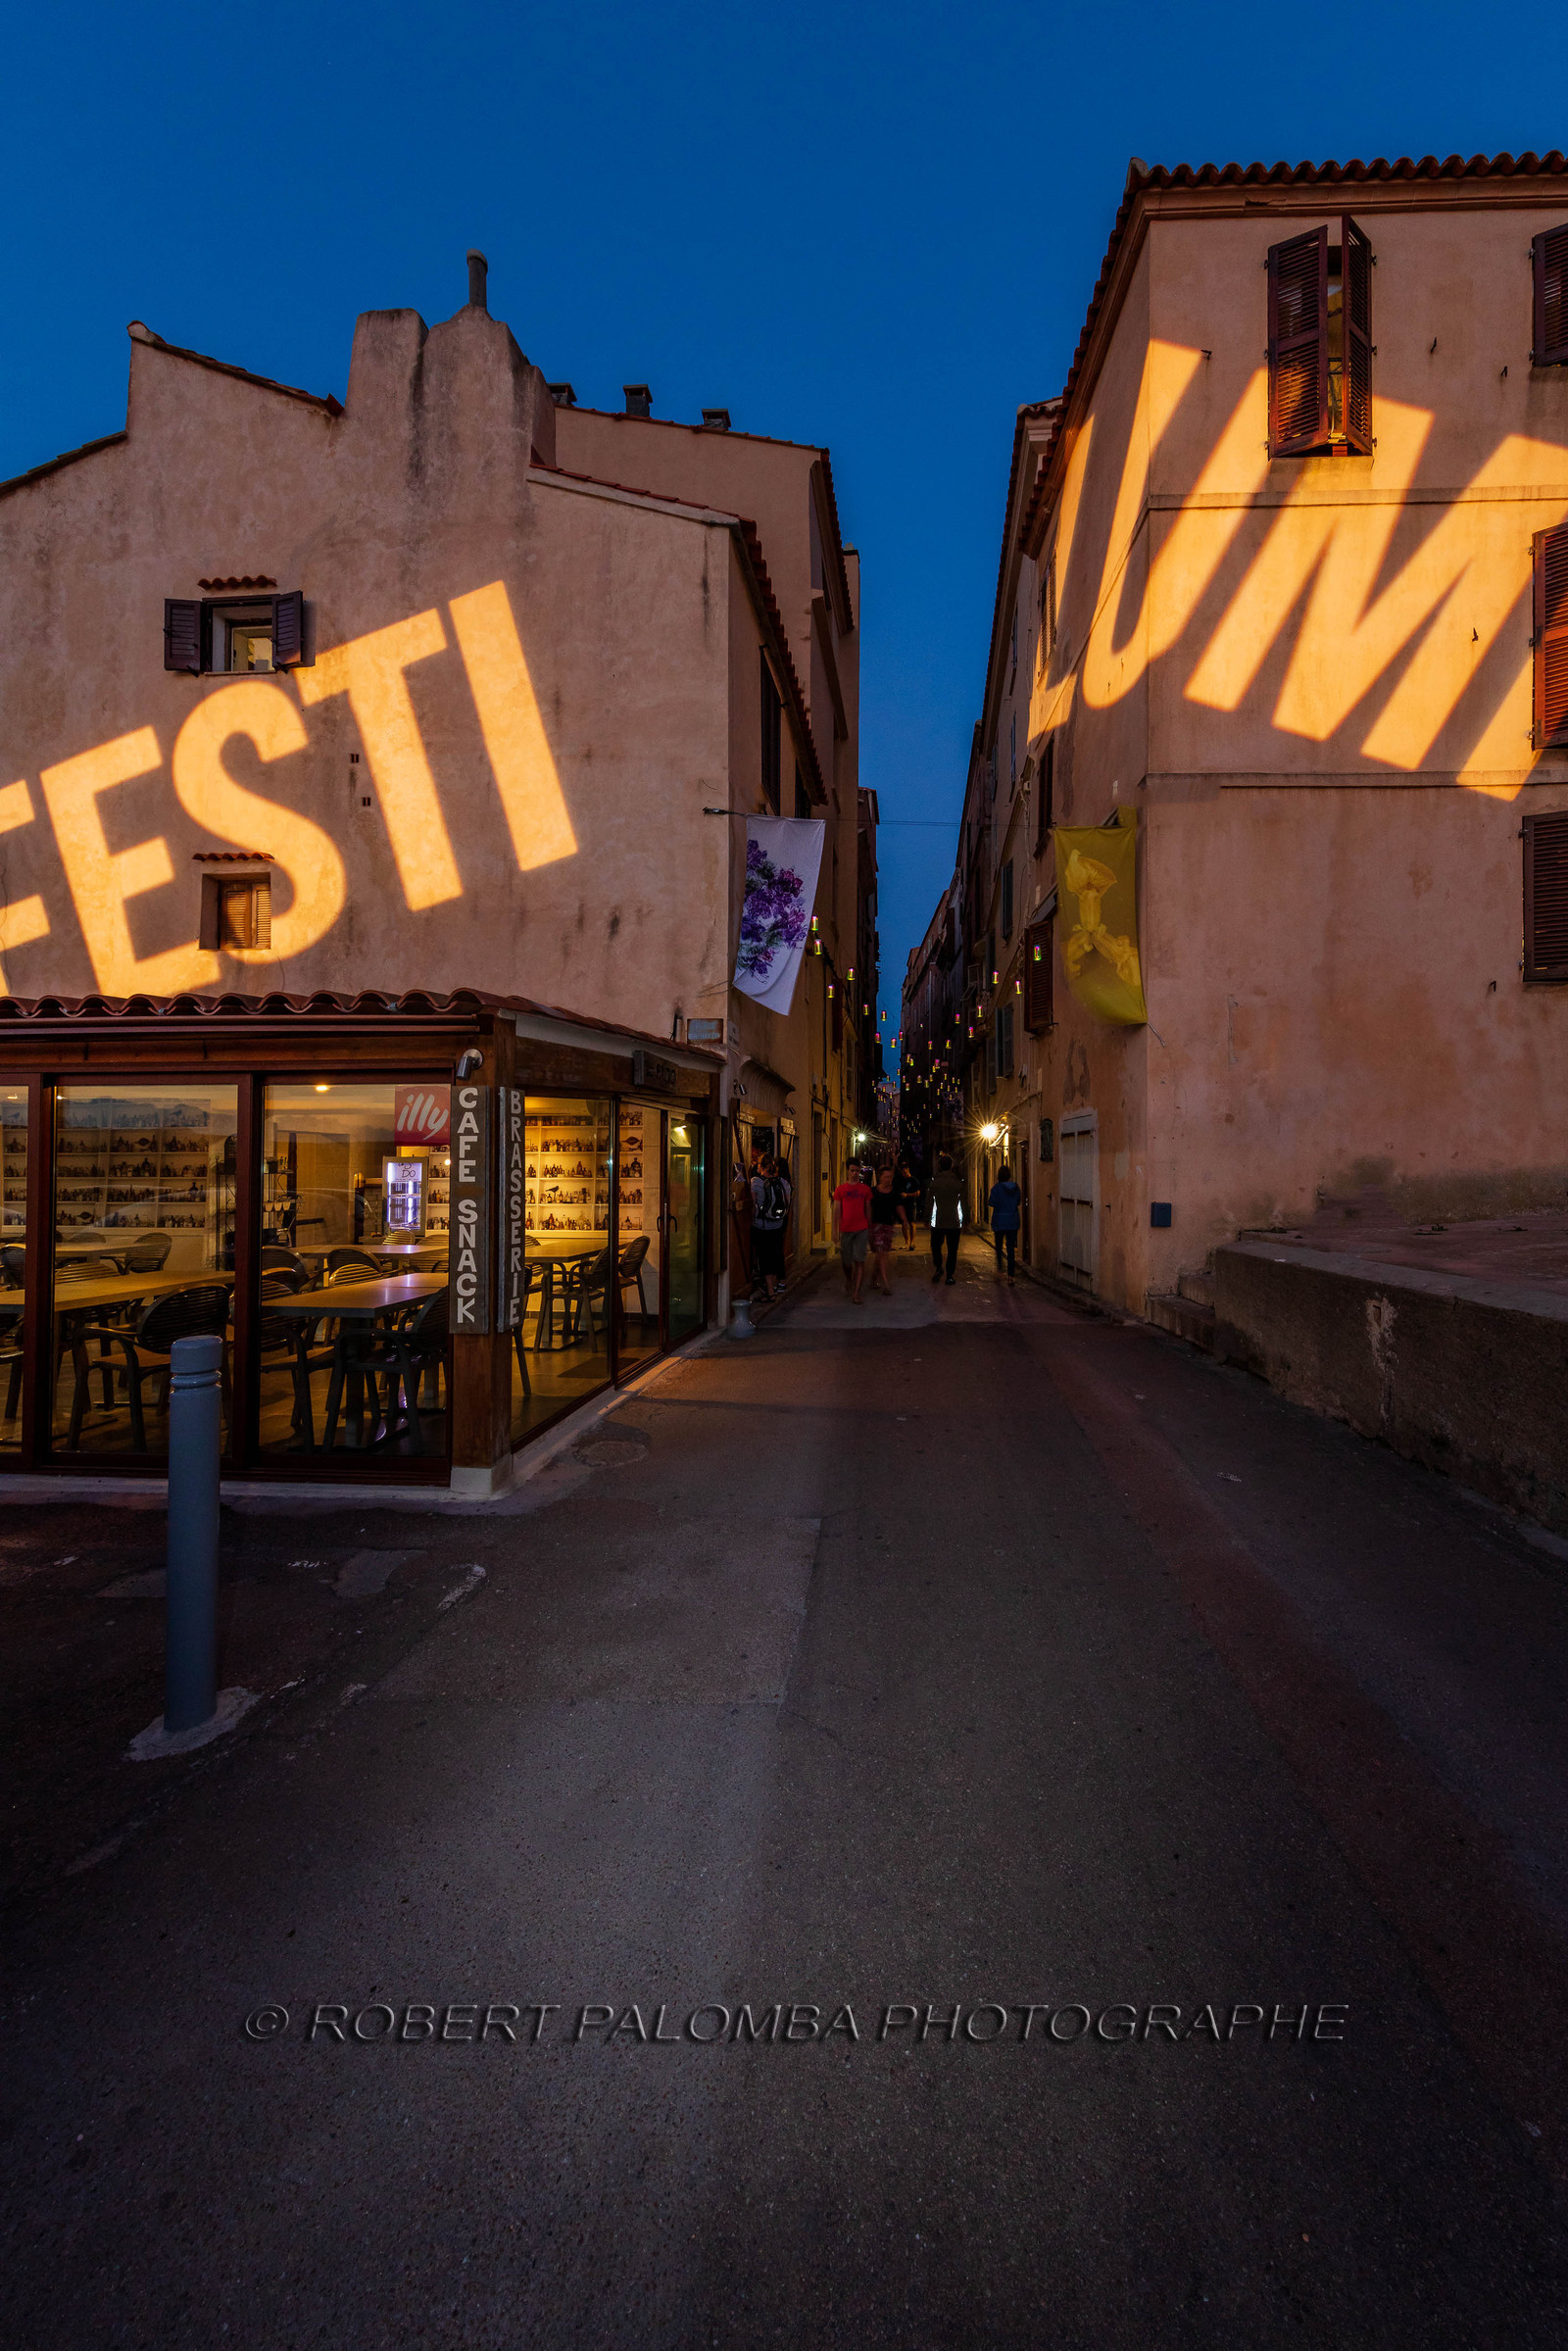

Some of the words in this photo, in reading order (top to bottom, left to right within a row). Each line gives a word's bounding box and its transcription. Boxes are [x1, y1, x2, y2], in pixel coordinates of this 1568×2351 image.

[396, 1092, 449, 1141] illy
[456, 1087, 480, 1183] CAFE
[455, 1199, 478, 1323] SNACK
